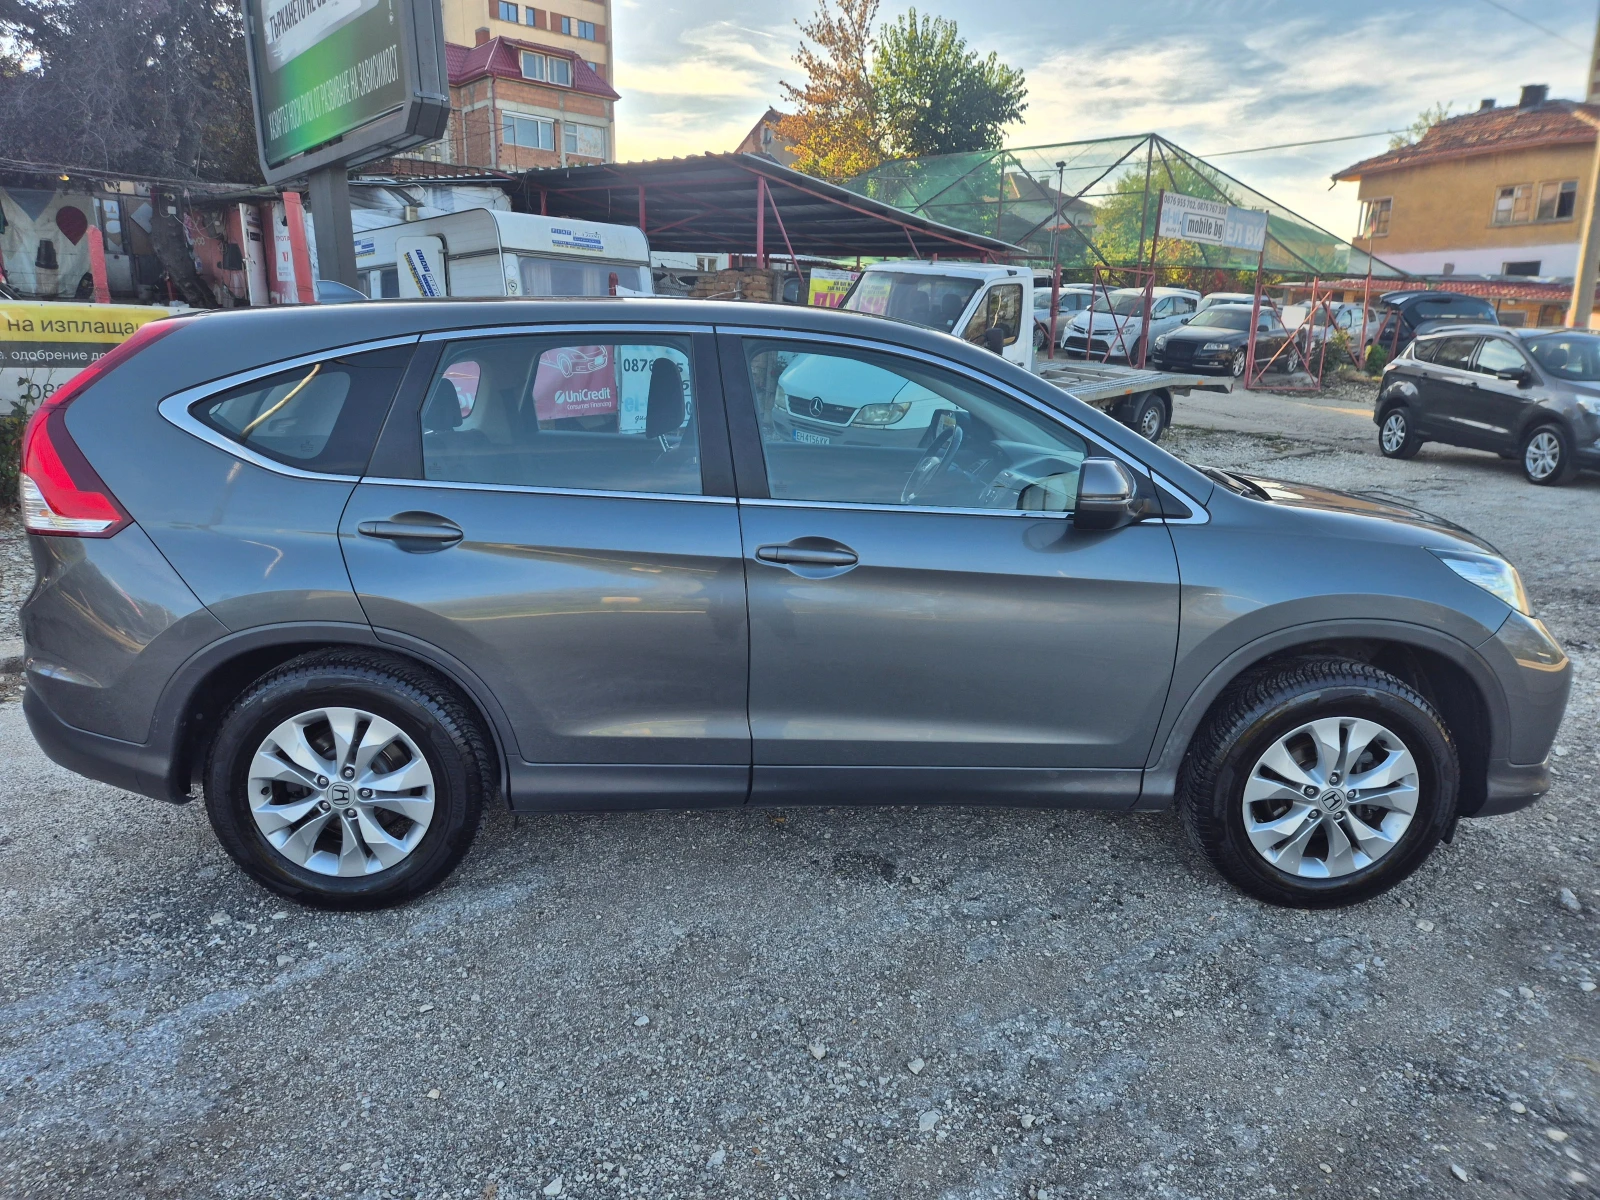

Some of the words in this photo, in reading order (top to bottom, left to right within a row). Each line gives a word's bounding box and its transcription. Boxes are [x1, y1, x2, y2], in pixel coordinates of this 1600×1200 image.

[349, 65, 360, 101] НА
[357, 44, 399, 96] ЗАВИСИМОСТ
[7, 318, 34, 332] на
[11, 350, 88, 363] одобрение
[565, 387, 611, 403] UniCredit
